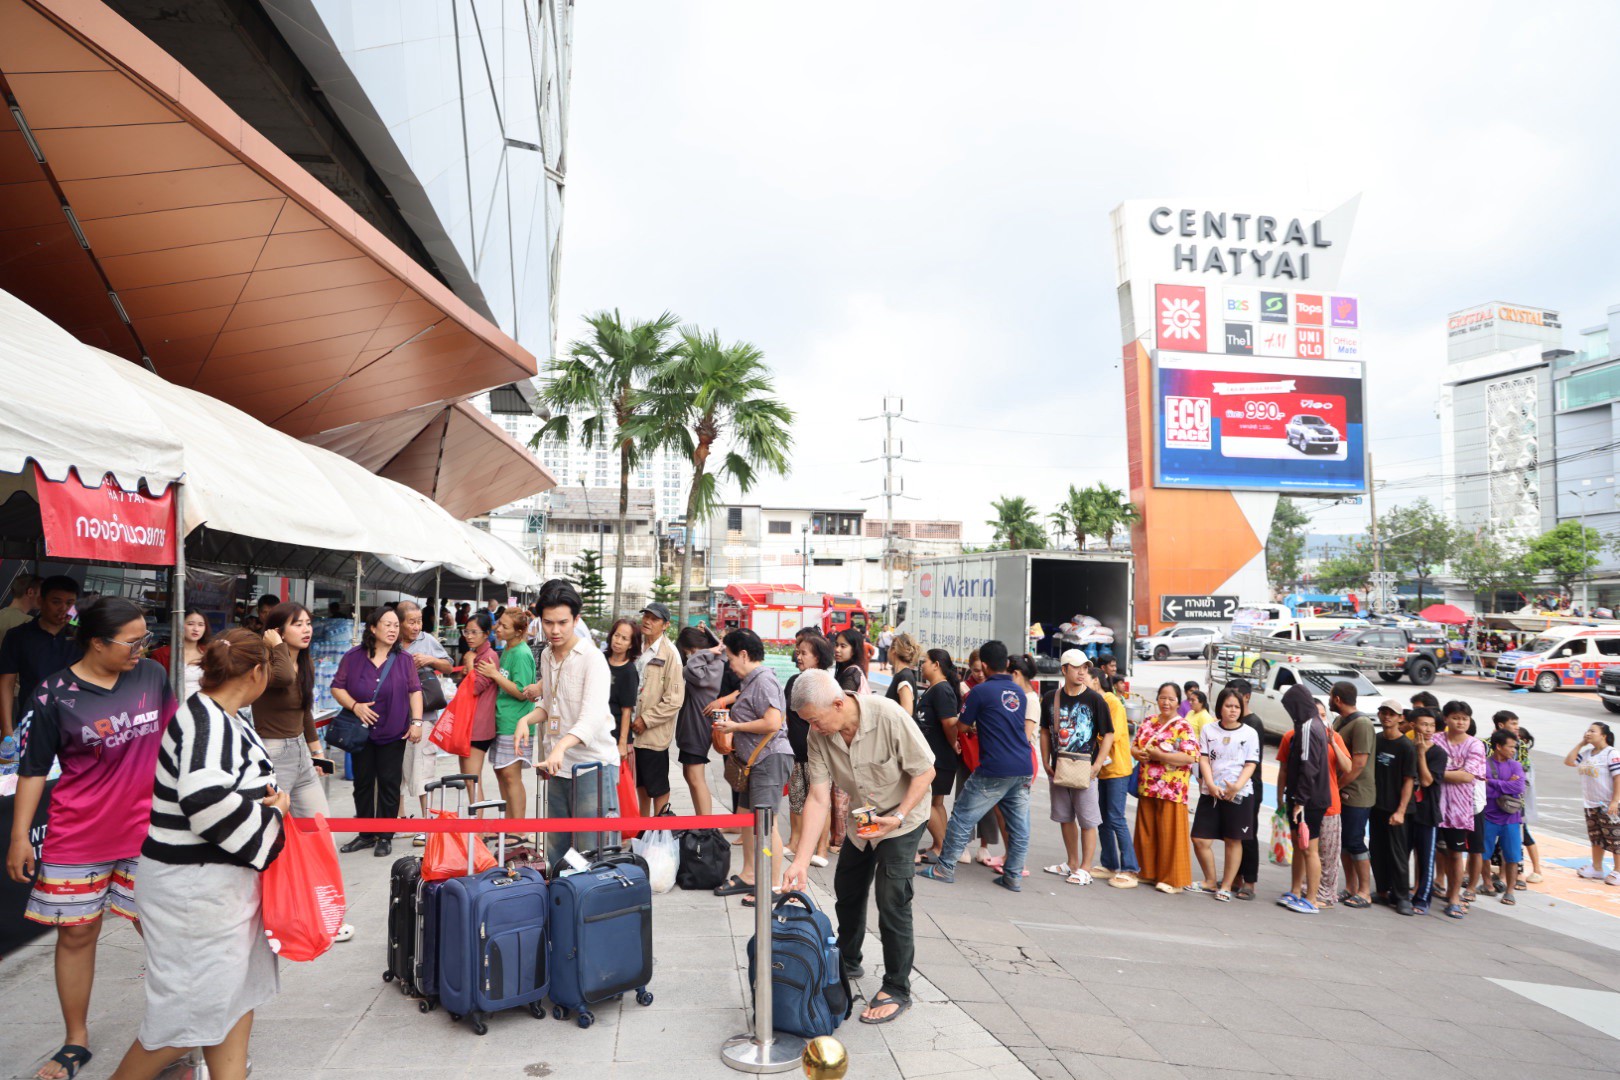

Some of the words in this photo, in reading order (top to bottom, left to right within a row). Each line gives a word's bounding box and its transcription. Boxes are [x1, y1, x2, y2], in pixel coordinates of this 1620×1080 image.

[1149, 206, 1333, 249] CENTRAL
[1174, 243, 1310, 280] HATYAI
[1227, 299, 1249, 311] B2S
[1296, 302, 1322, 315] Tops
[1498, 307, 1544, 326] CRYSTAL
[1226, 329, 1252, 347] The1
[1299, 331, 1320, 343] UNI
[1333, 336, 1357, 346] Office
[1299, 343, 1322, 357] QLO
[1338, 345, 1357, 354] Mate
[1167, 398, 1209, 430] ECO
[1167, 428, 1209, 441] PACK
[943, 575, 997, 598] Warn
[1184, 596, 1216, 608] ทางเข้า
[1184, 610, 1222, 618] ENTRANCE
[1223, 599, 1236, 618] 2
[81, 711, 132, 743] ARM
